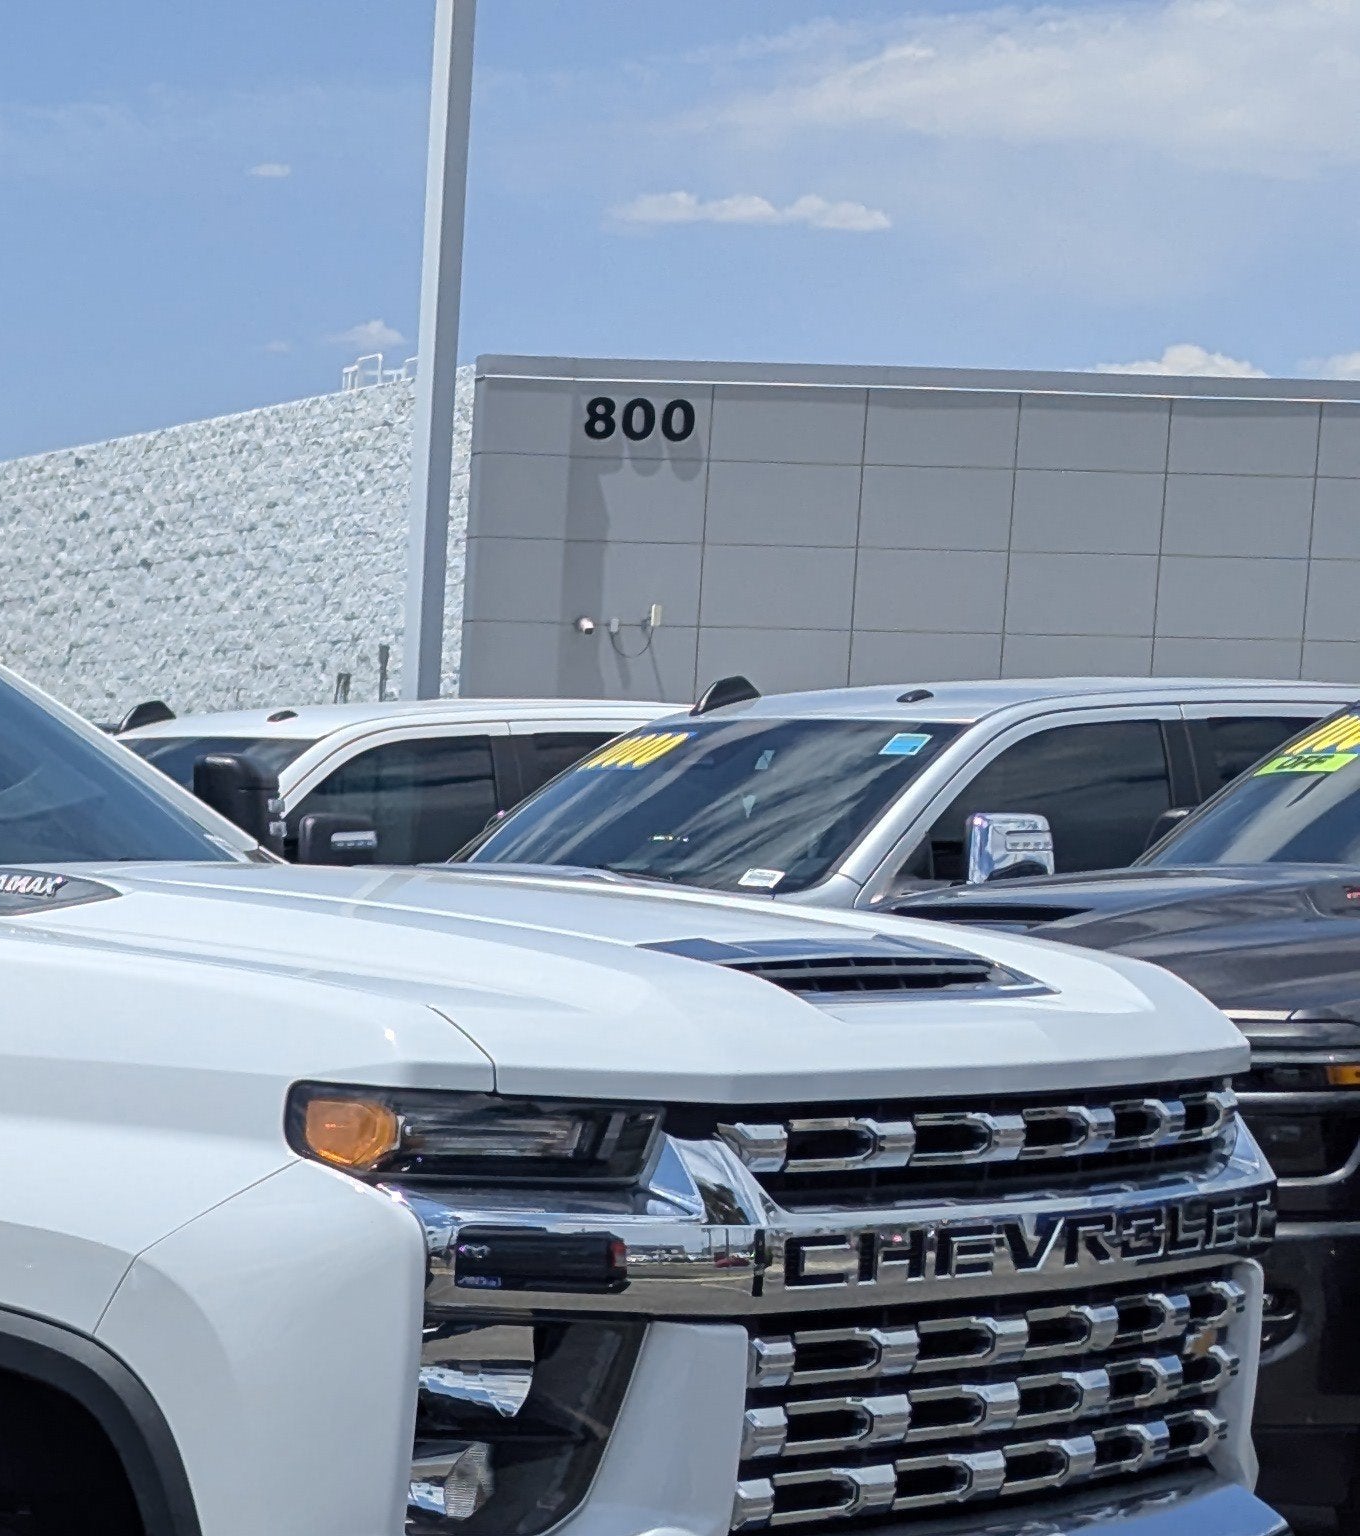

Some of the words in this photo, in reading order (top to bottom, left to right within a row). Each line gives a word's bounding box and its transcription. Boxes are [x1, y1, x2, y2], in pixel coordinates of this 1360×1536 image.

[584, 396, 696, 442] 800
[1275, 755, 1335, 770] OFF
[784, 1190, 1275, 1290] CHEVROLET
